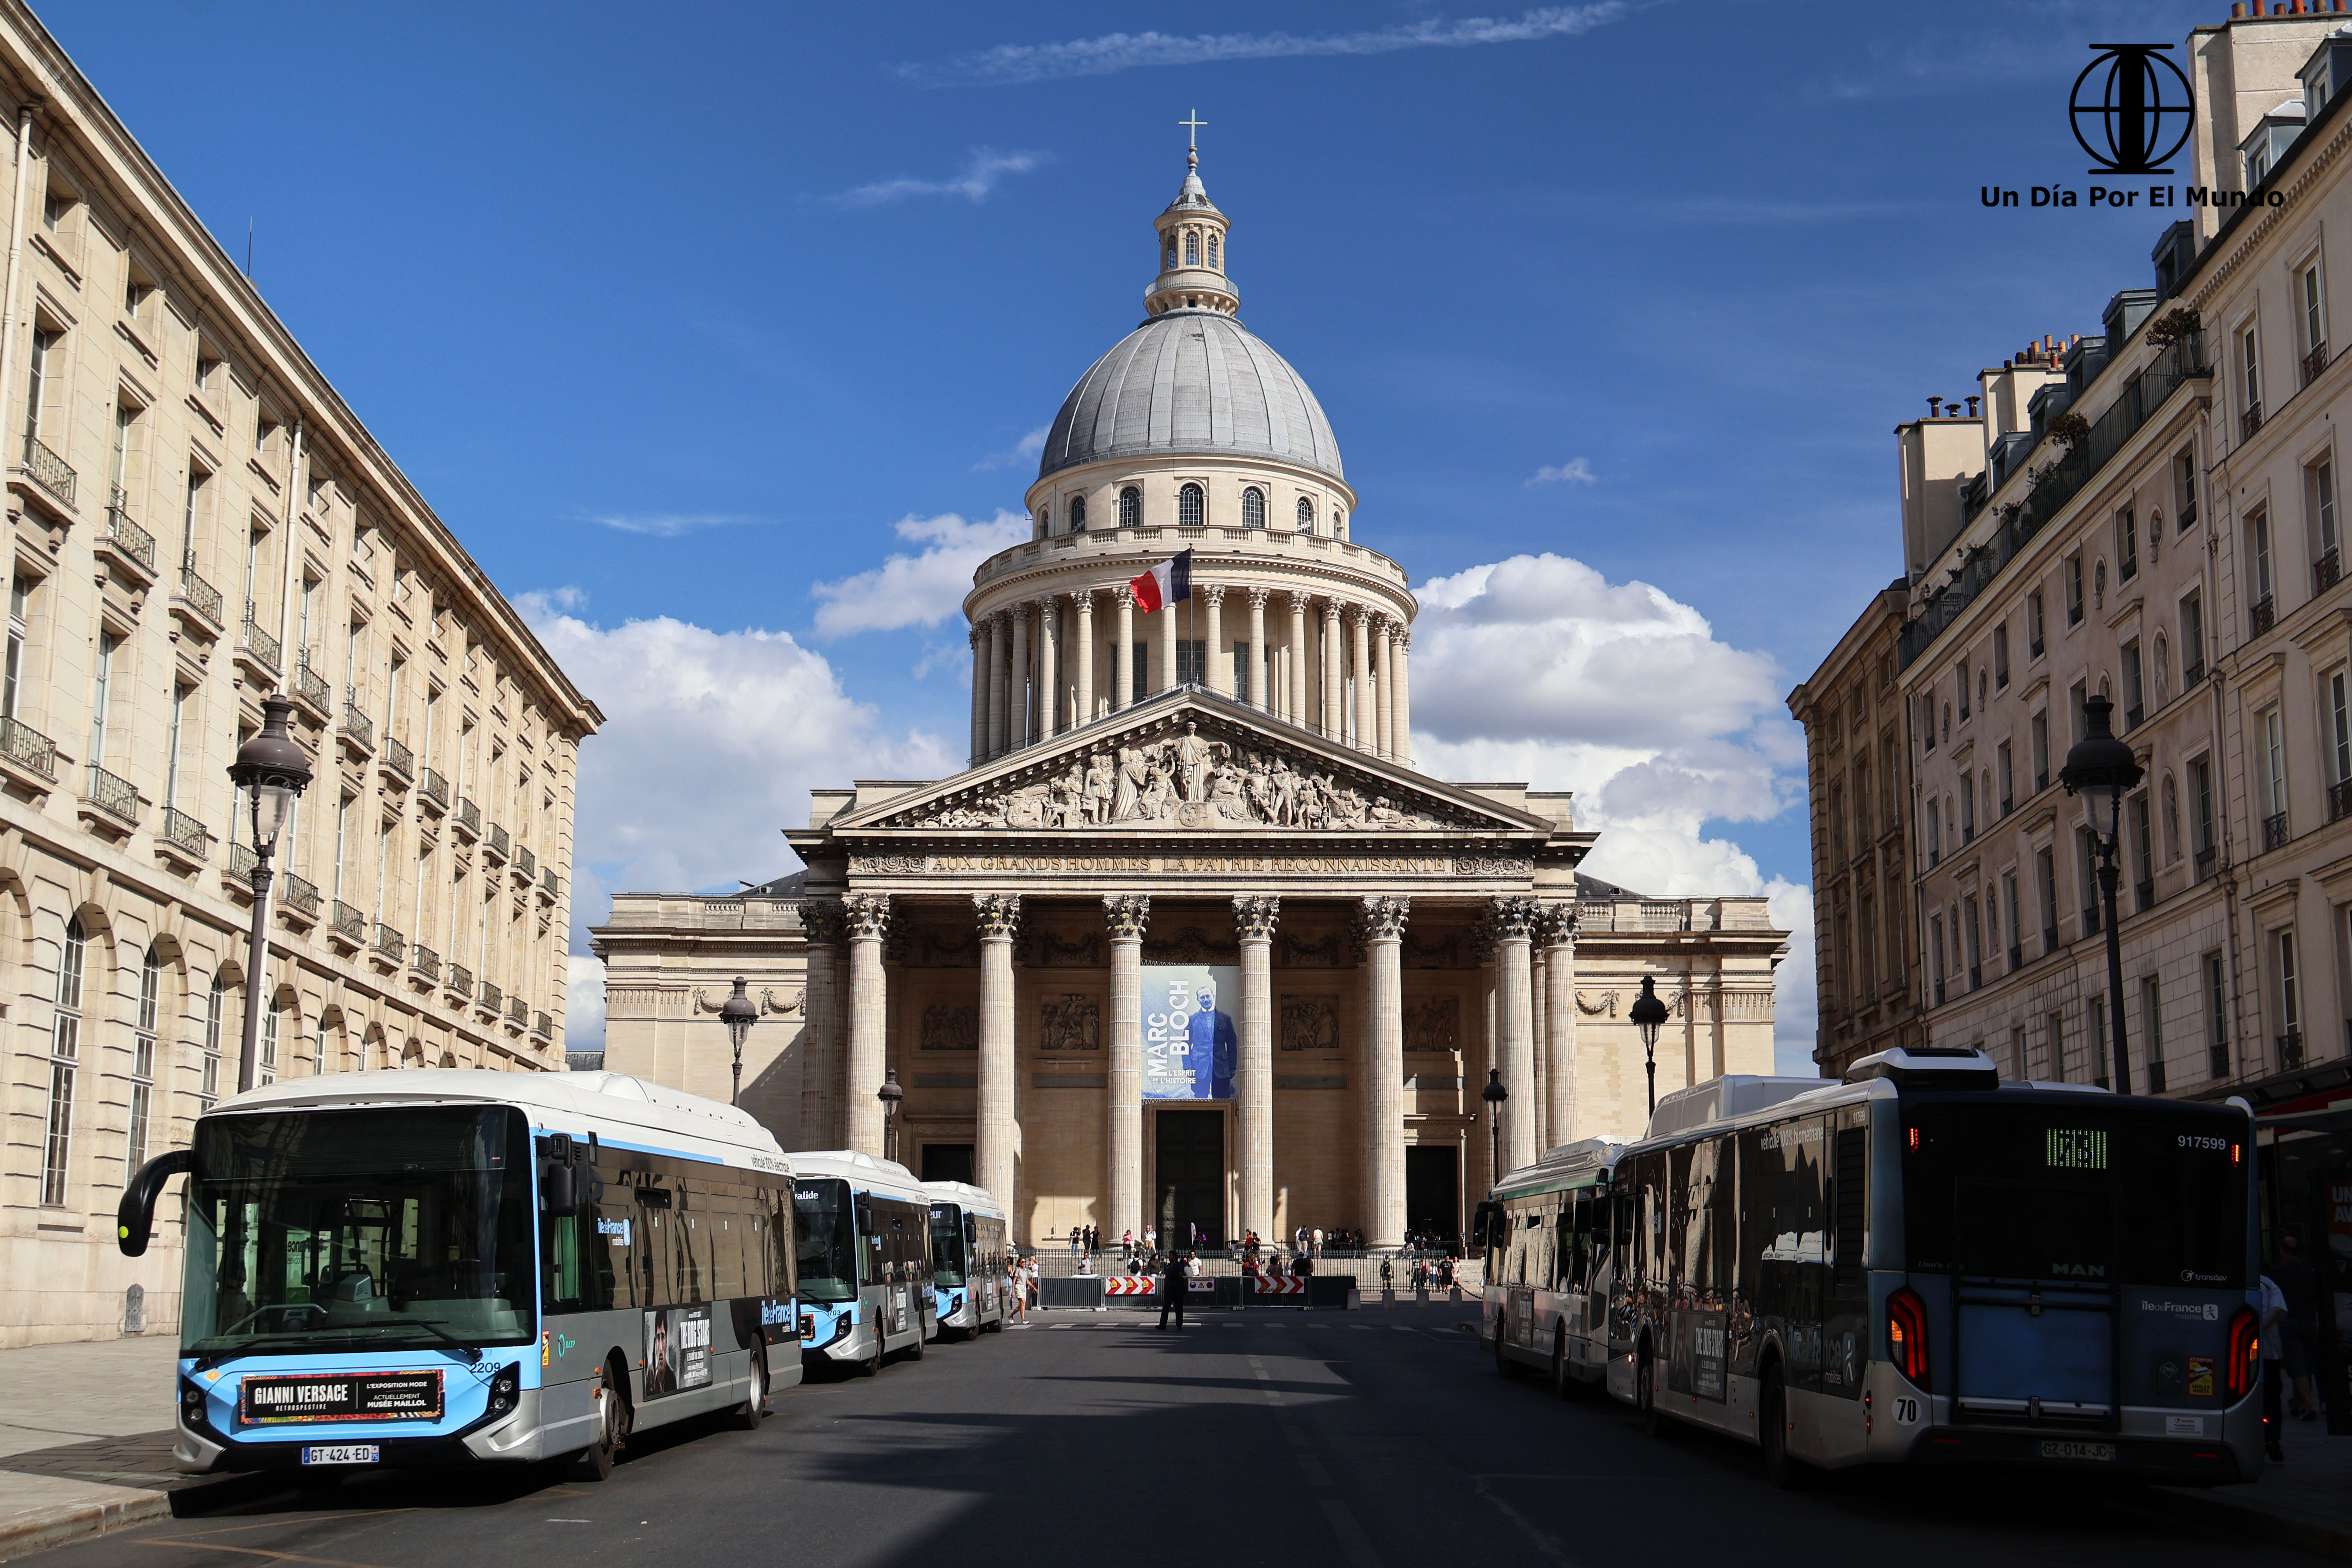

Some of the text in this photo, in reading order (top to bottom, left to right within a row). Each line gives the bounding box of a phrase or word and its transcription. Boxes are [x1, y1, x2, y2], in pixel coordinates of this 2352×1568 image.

[933, 856, 1446, 872] AUX GRANDS HOMMES LA PATRIE RECONNAISSANTE
[1169, 980, 1189, 1056] BLOCH
[1148, 1013, 1168, 1076] MARC
[1760, 1124, 1823, 1151] véhicule 100% biométhane
[2177, 1135, 2227, 1151] 917599
[2051, 1262, 2105, 1277] MAN
[2195, 1273, 2227, 1281] transdev
[687, 1320, 697, 1348] DOG
[697, 1318, 710, 1347] STARS
[565, 1340, 575, 1349] RATP
[1703, 1328, 1712, 1356] DOG
[1712, 1329, 1724, 1358] STARS
[470, 1362, 501, 1373] 2209
[1825, 1370, 1841, 1385] mobilités
[255, 1384, 348, 1405] GIANNI VERSACE
[275, 1403, 327, 1412] RETROSPECTIVE
[367, 1399, 427, 1408] MUSÉE MAILLOL
[1897, 1399, 1916, 1422] 70
